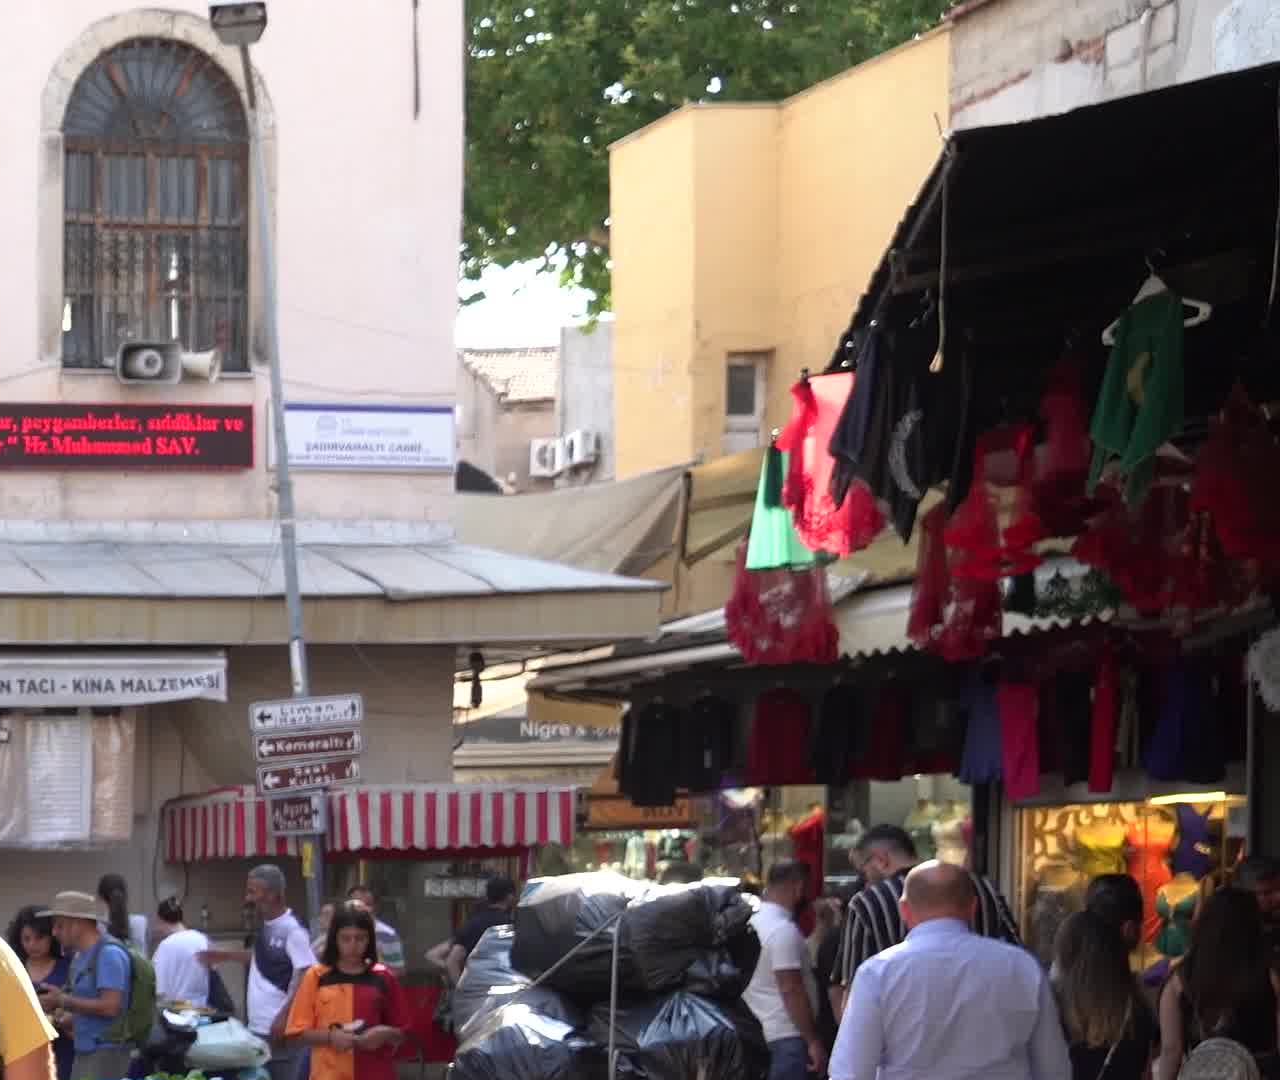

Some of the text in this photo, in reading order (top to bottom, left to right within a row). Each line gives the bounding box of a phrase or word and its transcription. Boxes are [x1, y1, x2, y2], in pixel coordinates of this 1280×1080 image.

[224, 417, 244, 432] ve
[18, 677, 56, 695] TACI
[71, 676, 113, 695] KINA
[120, 671, 221, 695] MALZEMESİ
